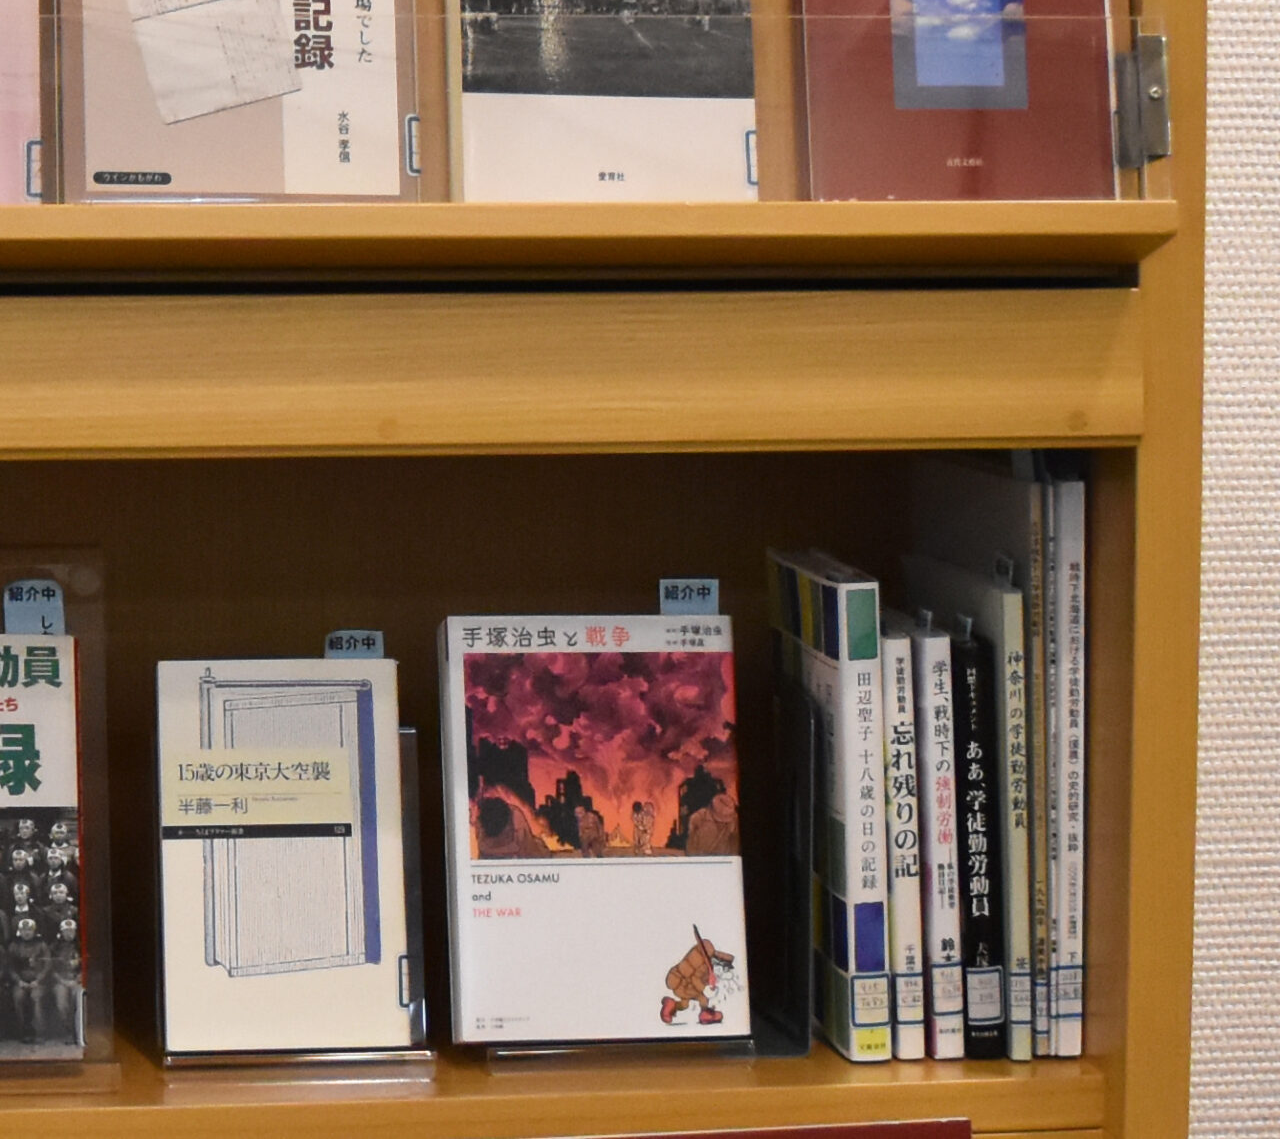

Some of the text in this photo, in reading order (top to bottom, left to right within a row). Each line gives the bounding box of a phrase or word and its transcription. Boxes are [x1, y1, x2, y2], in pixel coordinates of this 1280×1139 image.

[7, 586, 57, 603] 紹介中
[664, 584, 712, 601] 紹介中
[327, 635, 376, 651] 紹介中
[461, 625, 632, 648] 手塚治虫と戦争
[1006, 650, 1027, 829] 神奈川の学徒勤労動員
[932, 660, 954, 846] 学生、戦時下の強制労働
[177, 761, 331, 782] 15歳の東京大空襲
[856, 672, 878, 891] 田辺聖子 十八歳の日の記録
[177, 796, 249, 815] 半藤一利
[890, 721, 919, 879] 忘れ残りの記
[966, 741, 990, 917] ああ、学徒勤労動員
[470, 873, 561, 885] TEZUKA OSAMU
[472, 891, 492, 902] and
[472, 907, 523, 918] THE WAR
